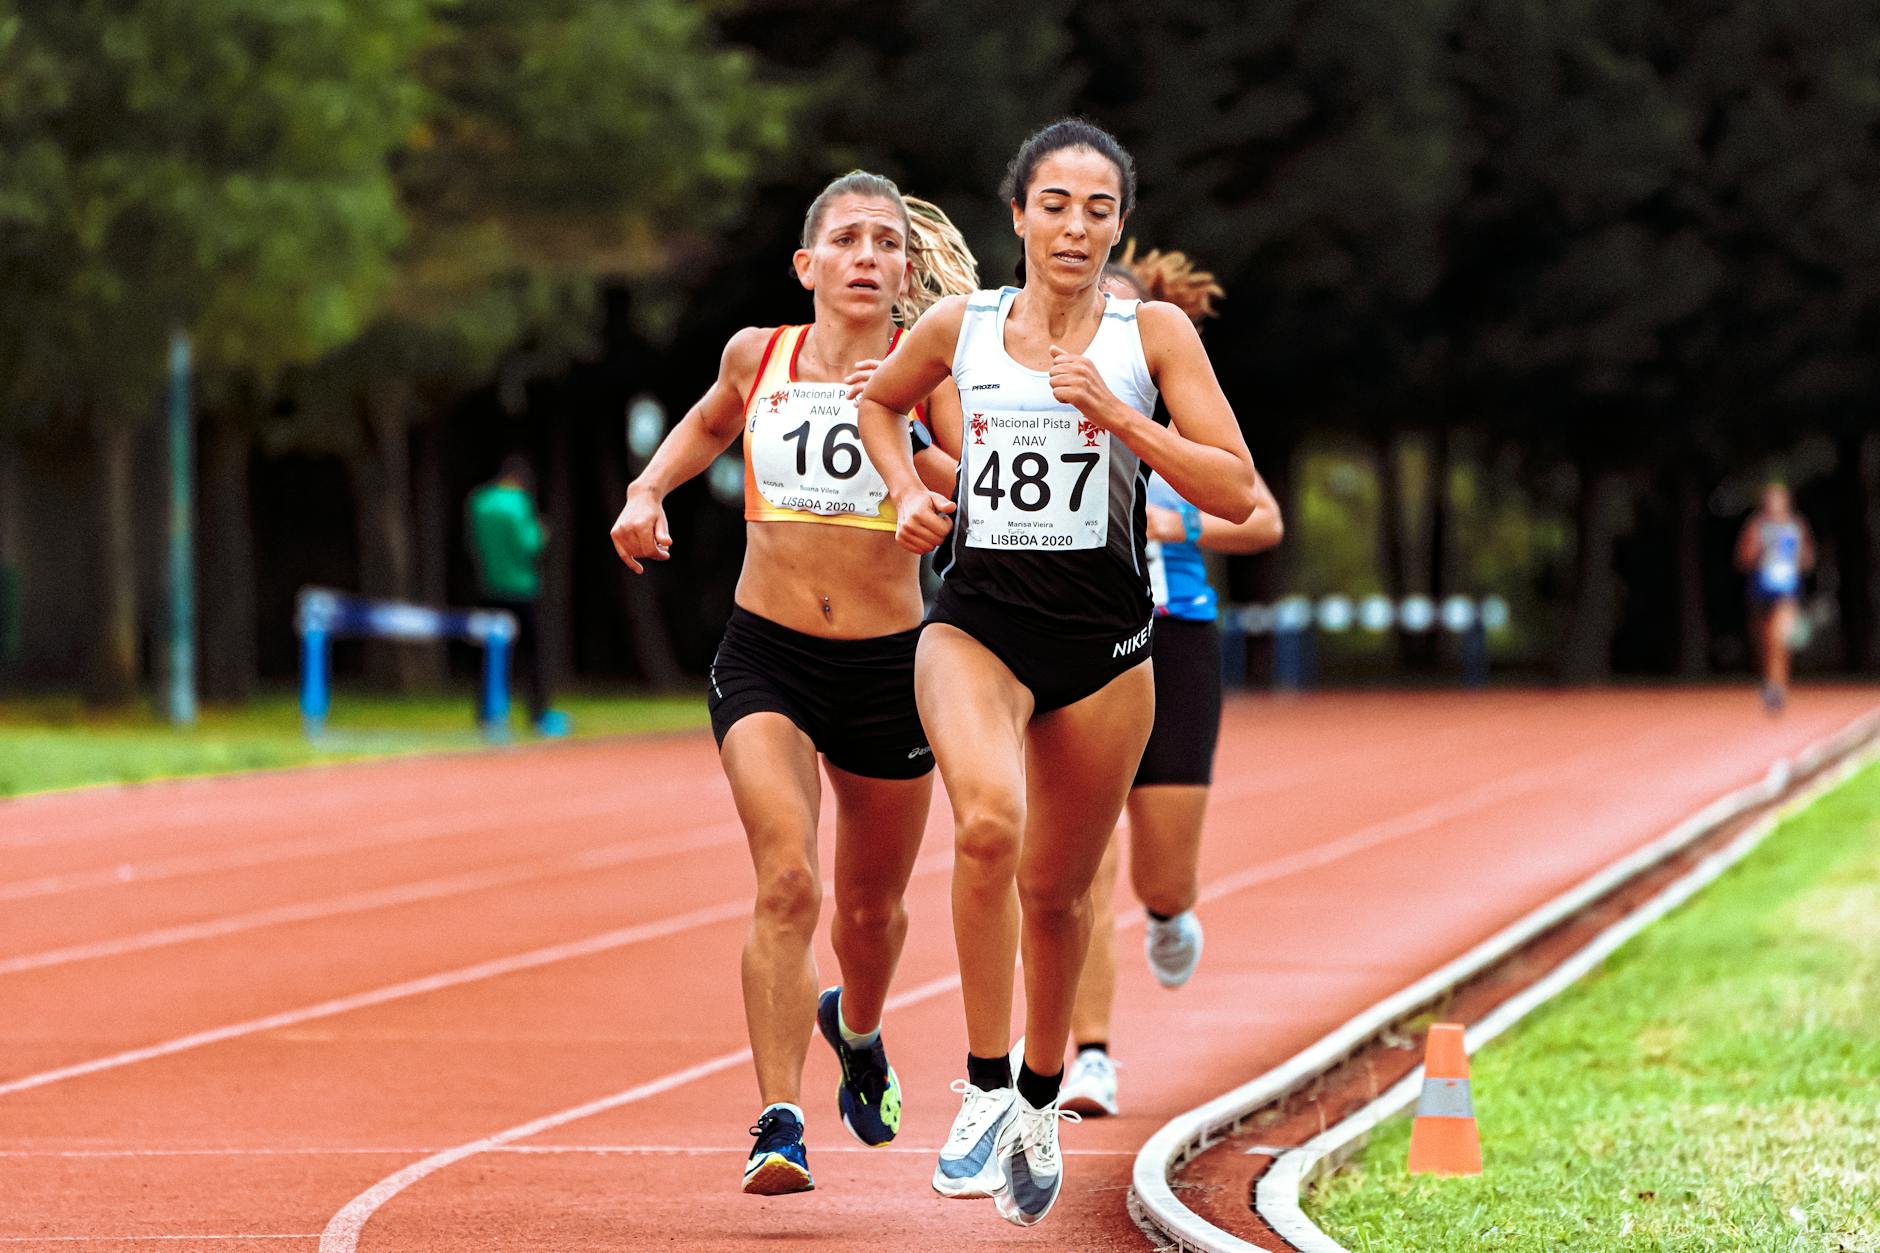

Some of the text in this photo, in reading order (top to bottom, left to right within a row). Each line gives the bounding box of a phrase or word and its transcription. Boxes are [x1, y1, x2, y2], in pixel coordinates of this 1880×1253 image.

[792, 389, 835, 399] Nacional
[810, 405, 841, 416] ANAV
[991, 417, 1071, 429] Nacional Pista
[1013, 436, 1047, 446] ANAV
[783, 420, 862, 480] 16
[973, 450, 1100, 512] 487
[781, 496, 855, 512] LISBOA 2020
[991, 535, 1073, 546] LISBOA 2020
[1112, 624, 1147, 658] NIKE
